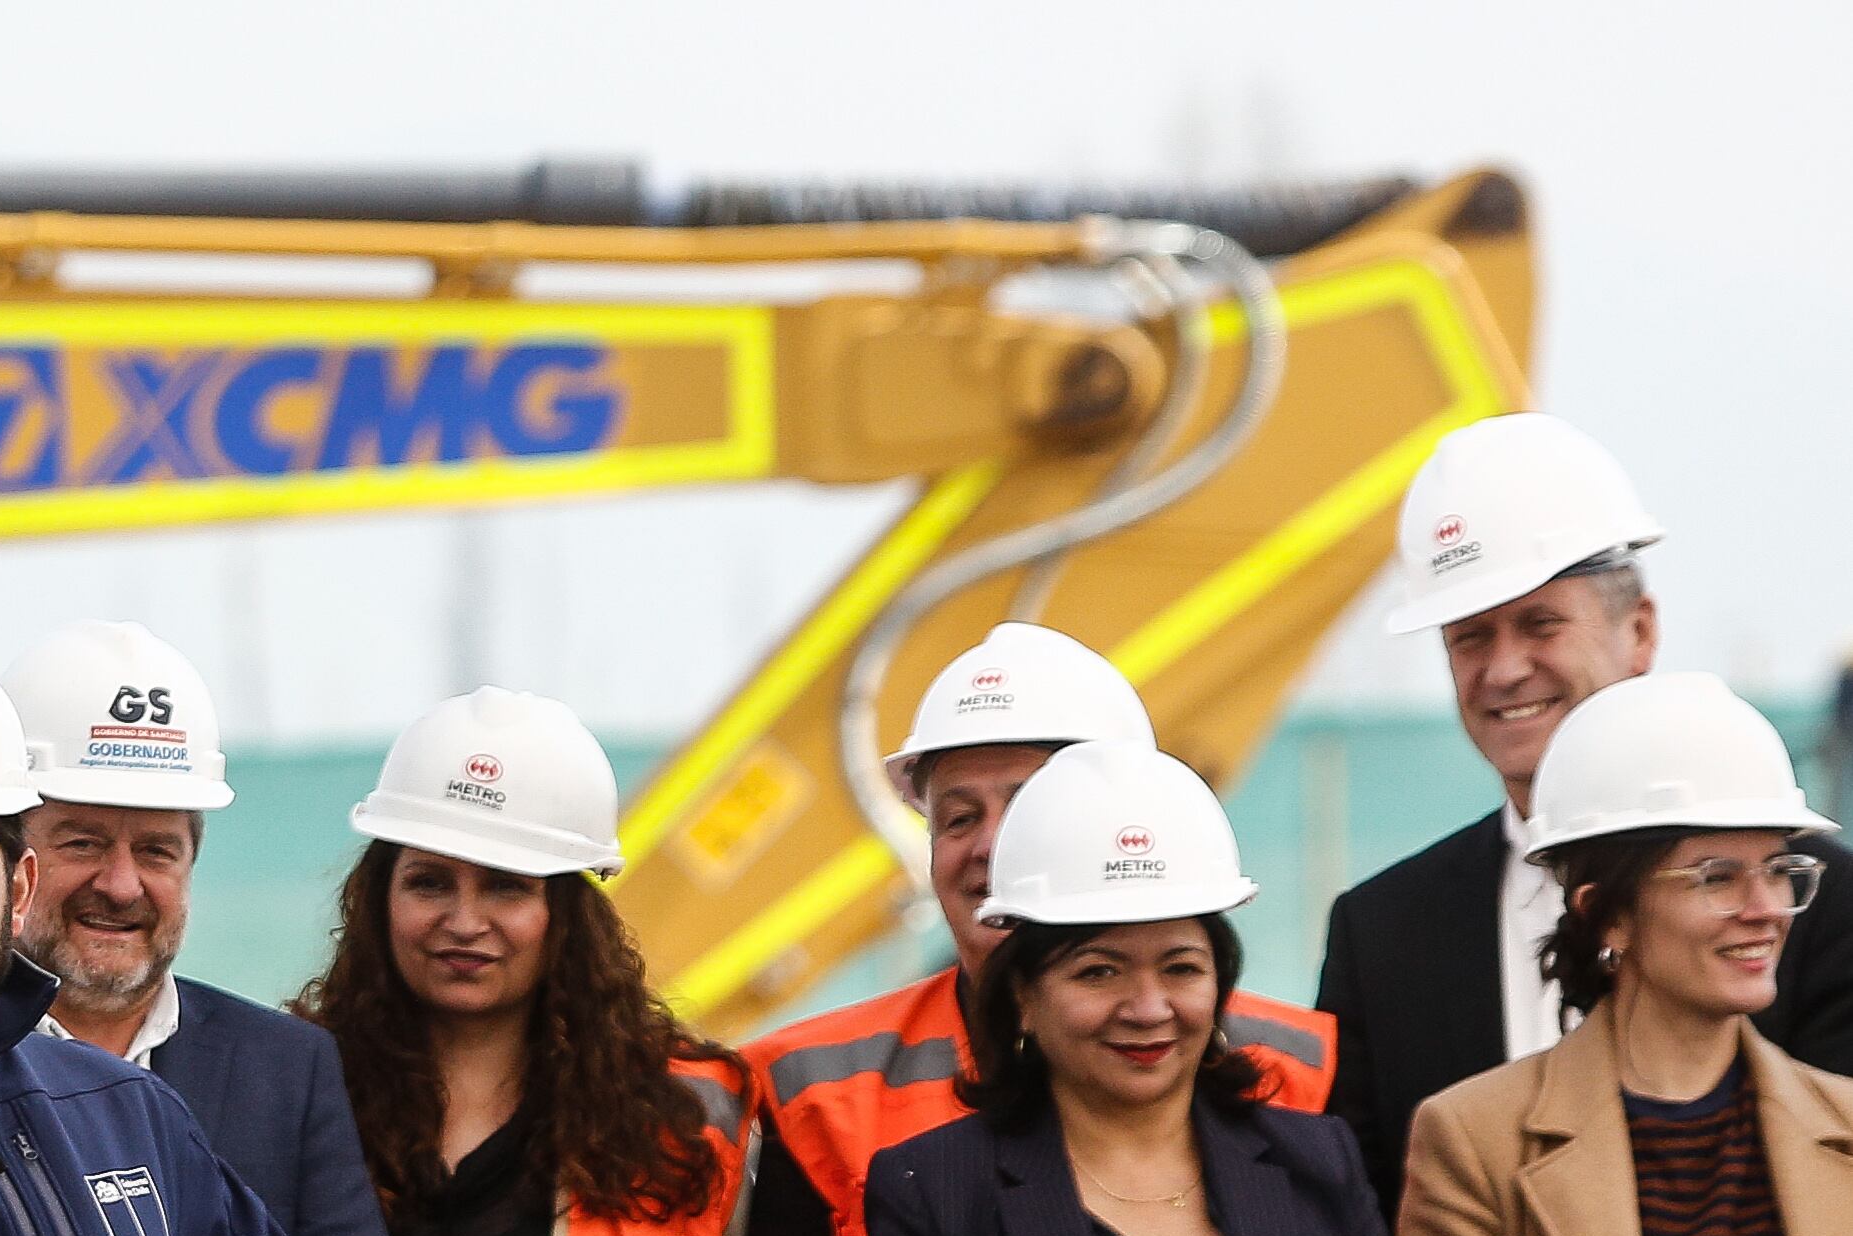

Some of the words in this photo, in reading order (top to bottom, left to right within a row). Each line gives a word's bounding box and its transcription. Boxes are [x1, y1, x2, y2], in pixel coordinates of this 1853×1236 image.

[91, 338, 624, 484] XCMG
[1432, 540, 1483, 568] METRO
[109, 685, 174, 725] GS
[958, 693, 1015, 707] METRO
[89, 742, 188, 760] GOBERNADOR
[448, 779, 506, 803] METRO
[1105, 860, 1166, 872] METRO
